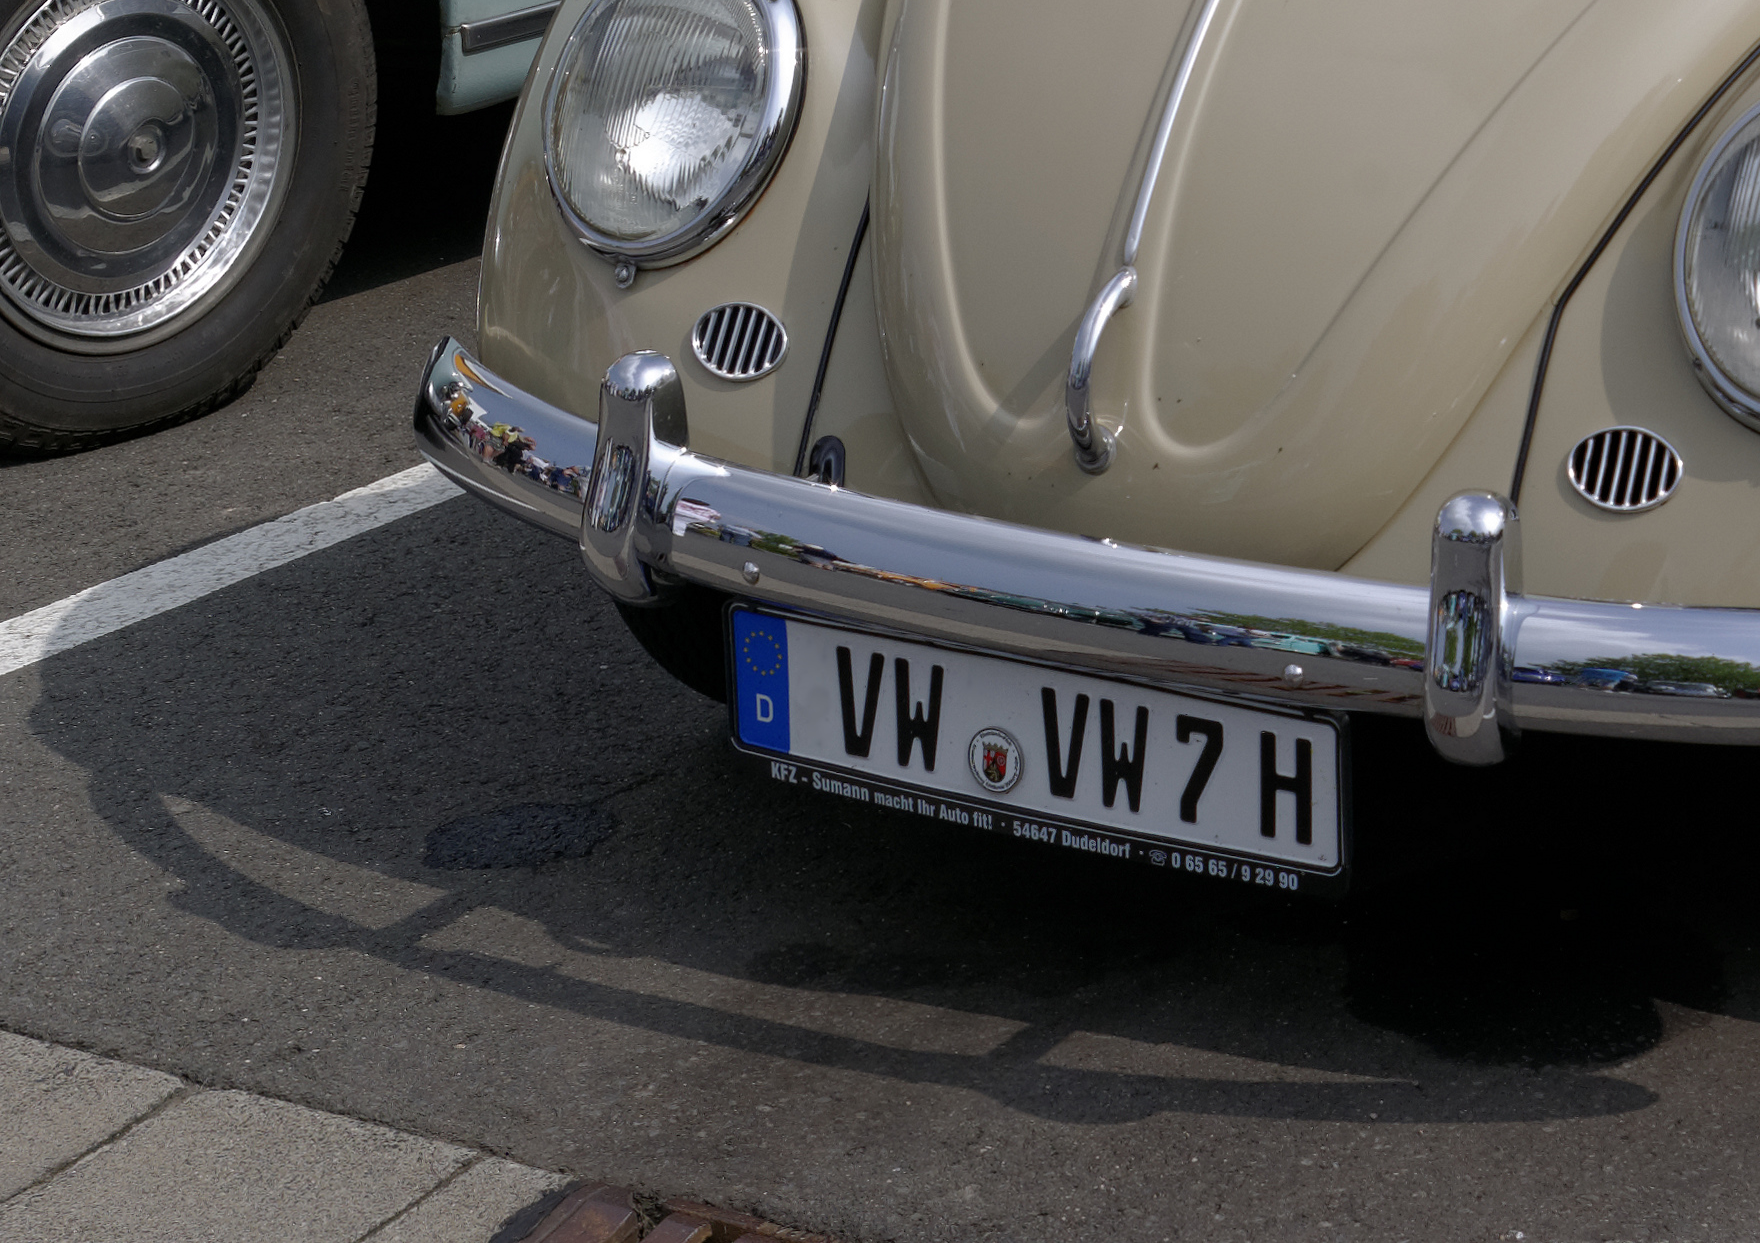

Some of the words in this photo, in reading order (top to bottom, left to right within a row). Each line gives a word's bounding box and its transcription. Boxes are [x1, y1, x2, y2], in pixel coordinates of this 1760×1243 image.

[756, 693, 774, 723] D
[836, 646, 944, 772] VW
[1041, 687, 1149, 813] VW
[771, 761, 798, 784] KFZ
[812, 771, 870, 802] Sumann
[874, 791, 915, 813] macht
[917, 799, 935, 817] Ihr
[940, 804, 970, 825] Auto
[973, 811, 993, 830] fit!
[1013, 820, 1057, 843] 54647
[1062, 830, 1131, 859] Dudeldorf
[1171, 852, 1182, 869] 0
[1185, 854, 1204, 873] 65
[1208, 859, 1228, 877] 65
[1241, 864, 1251, 882] 9
[1255, 867, 1274, 886] 29
[1279, 871, 1299, 890] 90
